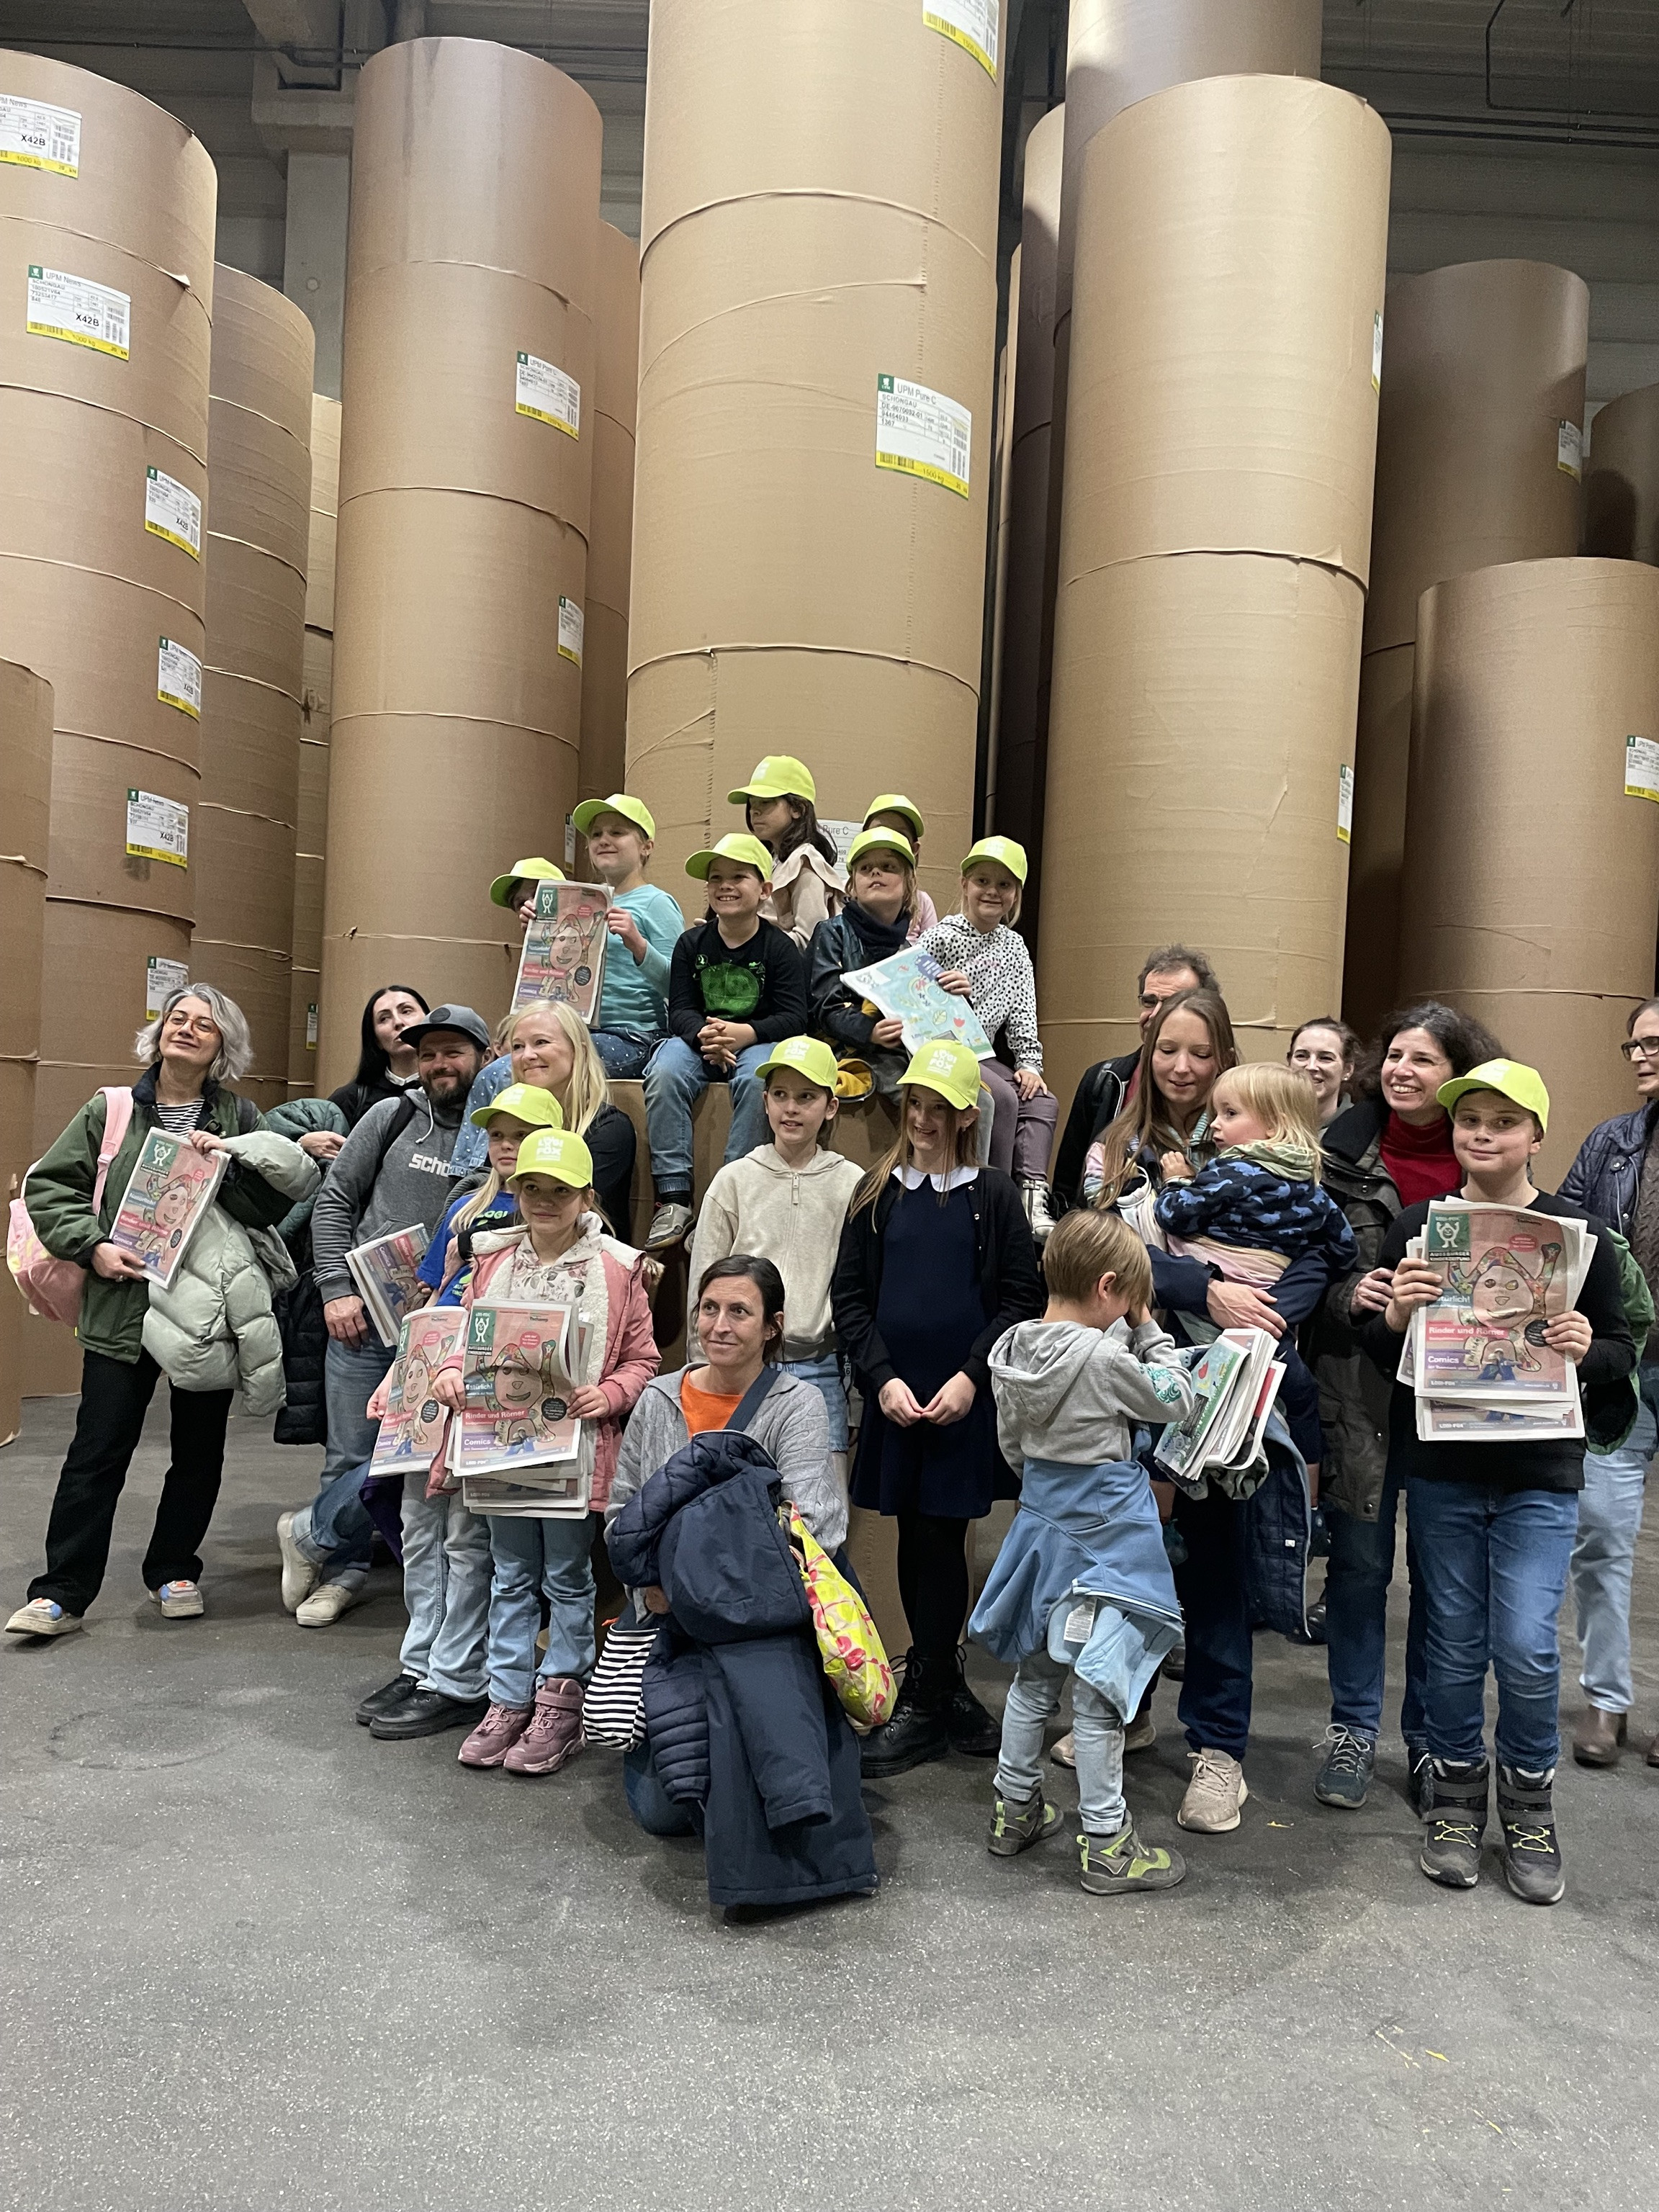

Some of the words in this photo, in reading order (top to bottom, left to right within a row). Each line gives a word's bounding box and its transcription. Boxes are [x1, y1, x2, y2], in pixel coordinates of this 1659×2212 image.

[9, 99, 27, 108] News
[21, 134, 46, 146] X42B
[46, 271, 62, 282] UPM
[63, 276, 81, 287] News
[76, 313, 99, 327] X42B
[897, 382, 914, 397] UPM
[915, 389, 930, 403] Pure
[931, 395, 937, 405] C
[882, 393, 917, 408] SCHONGAU
[823, 824, 840, 835] Pure
[842, 826, 849, 835] C
[933, 1049, 958, 1064] LOGI
[930, 1058, 954, 1070] FOX
[1429, 1326, 1456, 1335] Rinder
[1457, 1326, 1475, 1335] und
[1428, 1355, 1460, 1364] Comics
